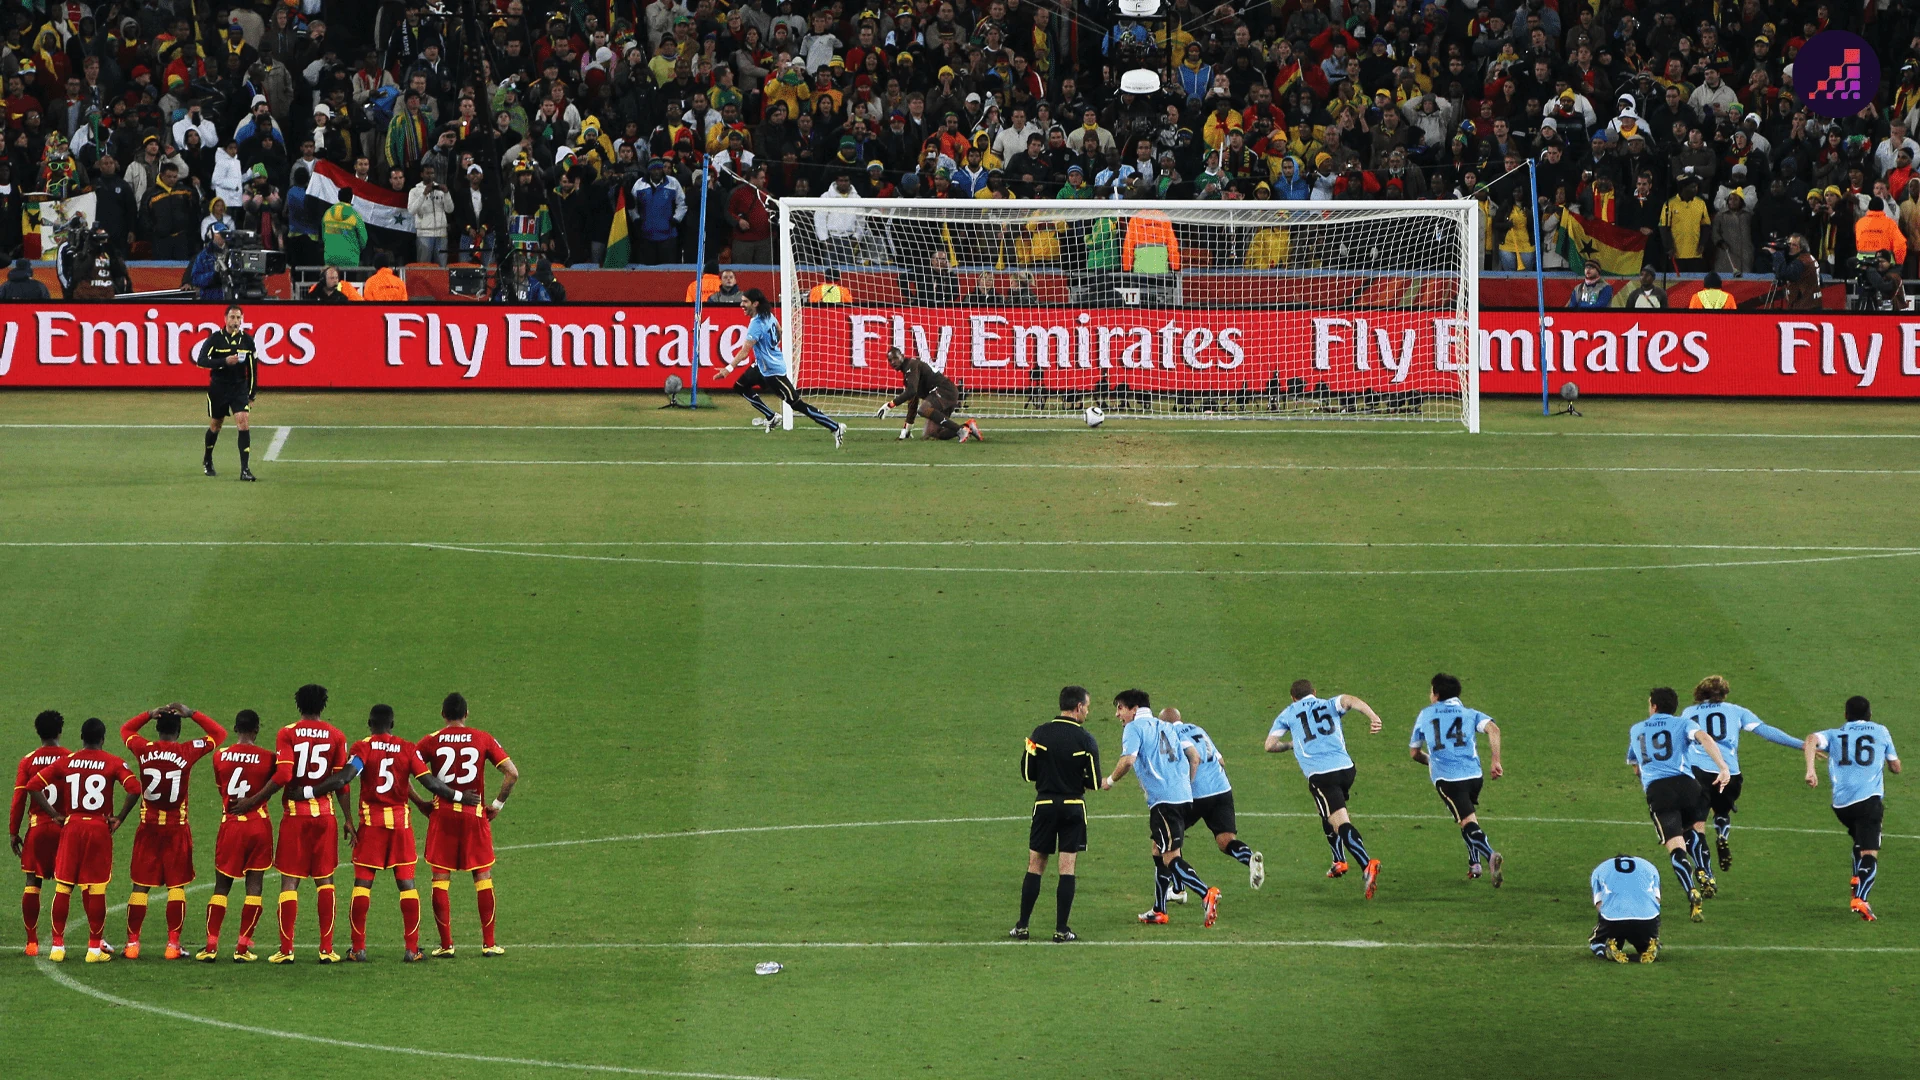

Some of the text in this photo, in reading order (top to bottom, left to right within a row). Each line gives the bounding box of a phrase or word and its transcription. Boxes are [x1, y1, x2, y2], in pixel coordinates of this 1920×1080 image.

[36, 308, 316, 365] Emires
[385, 313, 489, 378] Fly
[506, 311, 750, 366] Emirate
[849, 314, 953, 373] Fly
[970, 312, 1245, 369] Emirates
[1312, 318, 1416, 383] Fly
[1433, 316, 1710, 373] Emirates
[1778, 321, 1883, 387] Fly
[295, 728, 330, 739] VORSAH
[438, 733, 473, 743] PRINCE
[1295, 705, 1335, 743] 15
[1430, 716, 1466, 751] 14
[32, 755, 60, 766] ANNA
[139, 750, 188, 769] K.ASAMOAH
[220, 752, 260, 764] PANTSIL
[293, 741, 331, 780] 15
[1160, 730, 1178, 762] 4
[1637, 730, 1673, 765] 19
[1837, 734, 1875, 766] 16
[67, 759, 105, 770] ADIYIAH
[376, 757, 394, 794] 5
[436, 746, 480, 784] 23
[65, 772, 106, 811] 18
[143, 768, 182, 803] 21
[227, 767, 251, 799] 4
